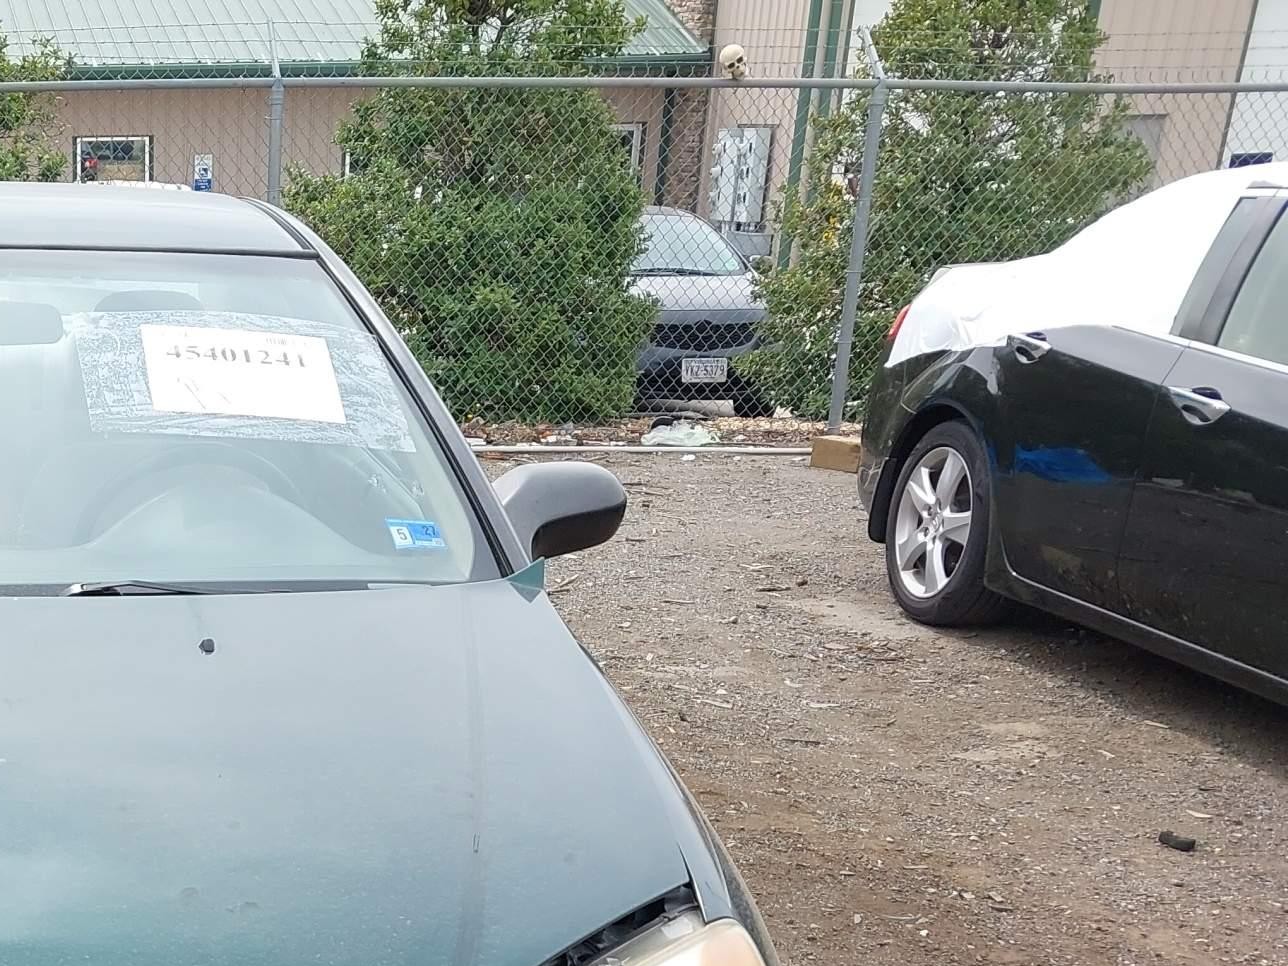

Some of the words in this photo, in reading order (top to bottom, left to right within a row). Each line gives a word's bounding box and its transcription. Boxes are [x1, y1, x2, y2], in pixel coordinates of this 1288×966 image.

[165, 344, 306, 368] 45401241
[396, 528, 408, 541] 5
[422, 525, 436, 537] 27
